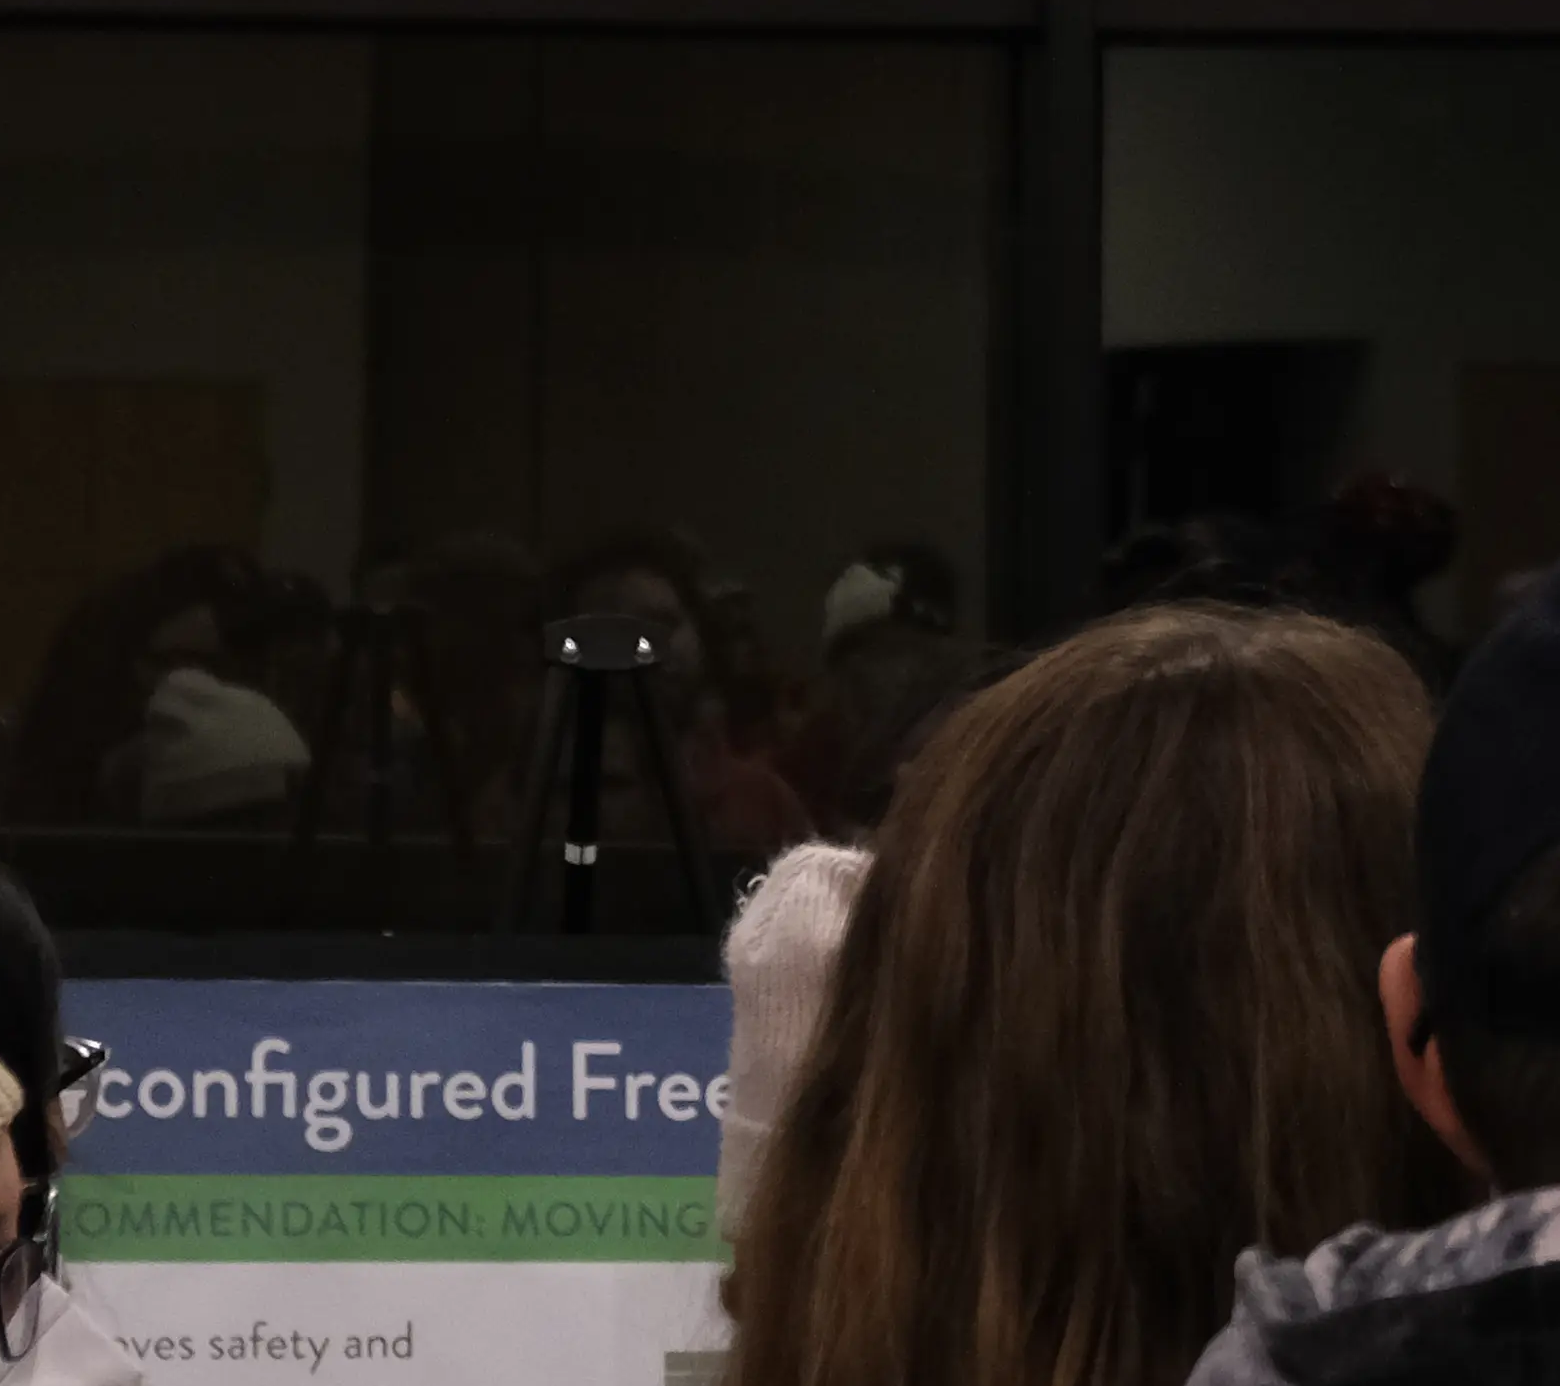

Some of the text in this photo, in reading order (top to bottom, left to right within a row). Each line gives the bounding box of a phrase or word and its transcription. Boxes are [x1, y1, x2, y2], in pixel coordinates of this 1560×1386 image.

[501, 1201, 709, 1240] MOVING
[208, 1320, 330, 1375] safety
[343, 1320, 414, 1360] and
